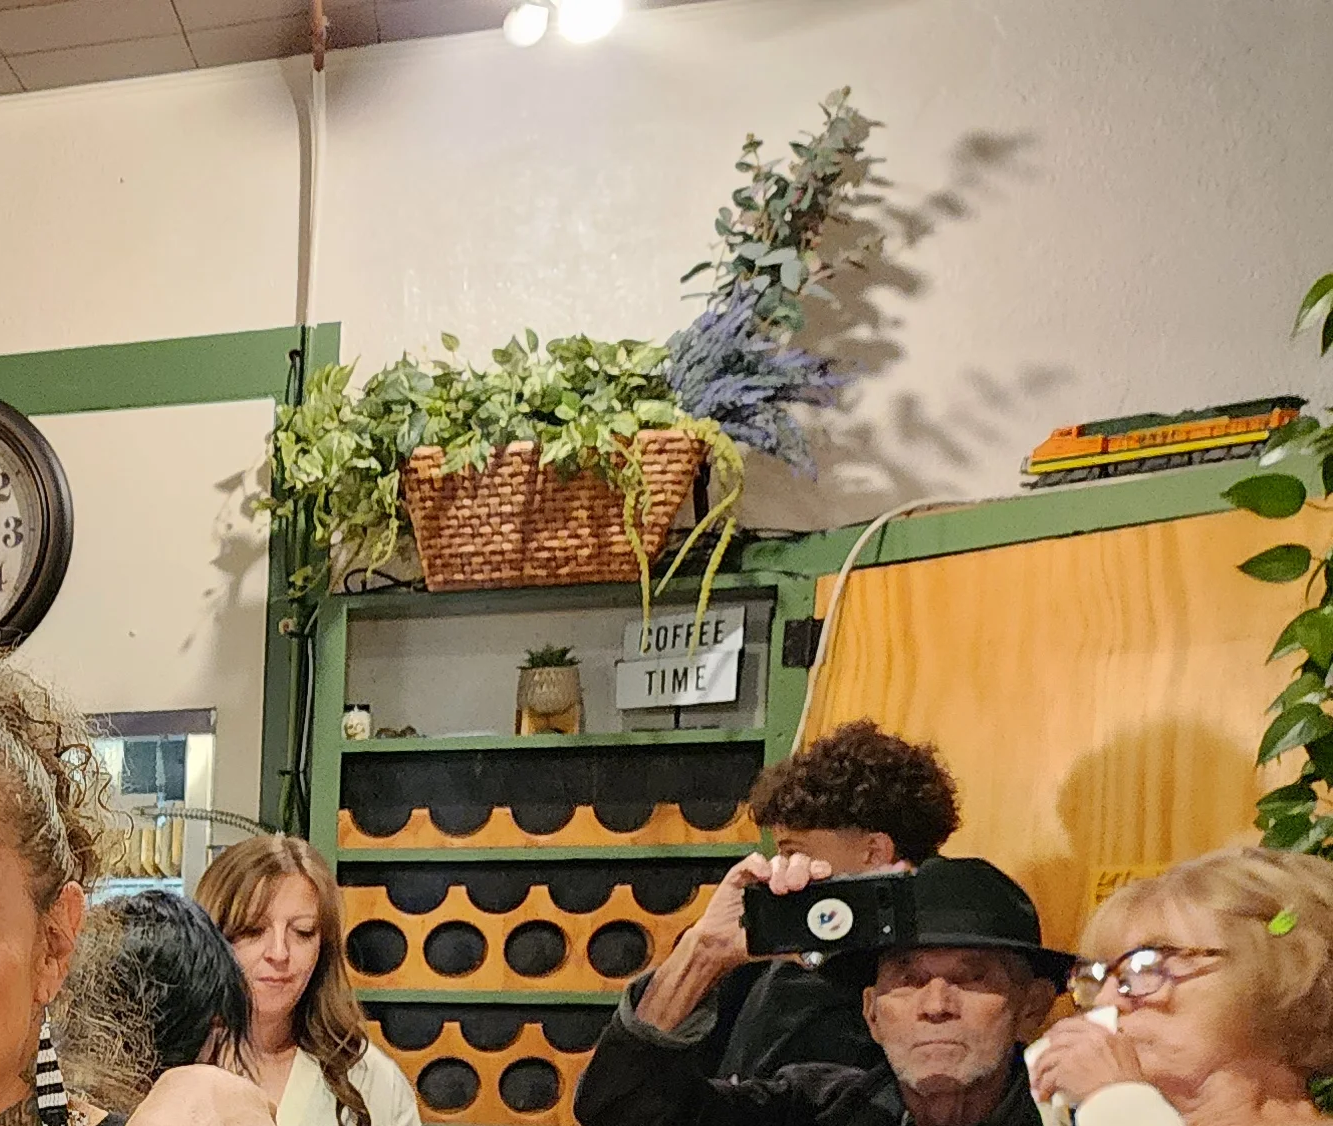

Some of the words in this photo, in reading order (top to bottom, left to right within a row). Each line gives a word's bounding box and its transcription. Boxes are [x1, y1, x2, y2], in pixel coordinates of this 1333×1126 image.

[3, 516, 25, 548] 3
[639, 620, 727, 654] COFFEE
[645, 665, 707, 696] TIME
